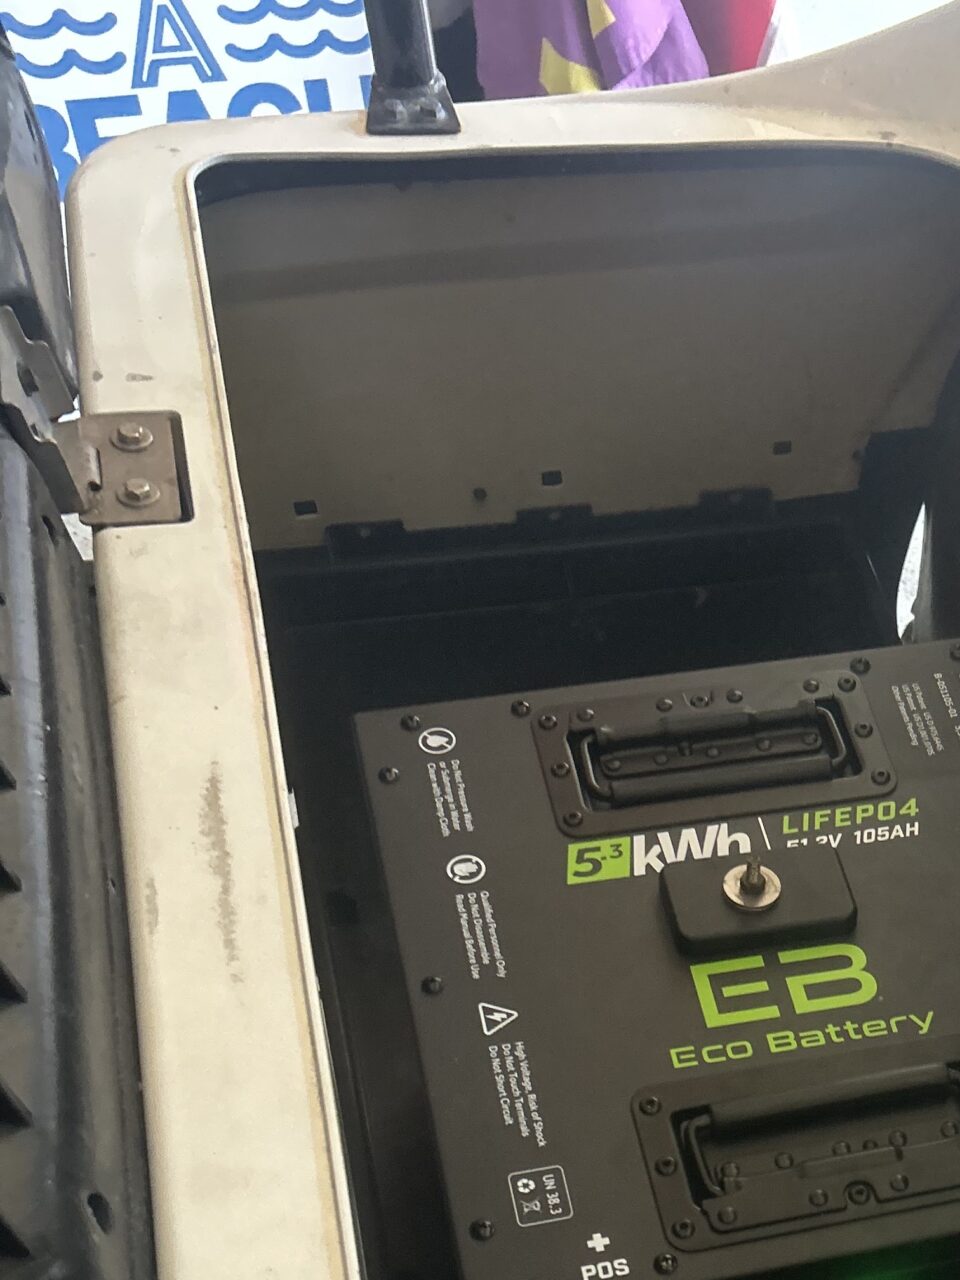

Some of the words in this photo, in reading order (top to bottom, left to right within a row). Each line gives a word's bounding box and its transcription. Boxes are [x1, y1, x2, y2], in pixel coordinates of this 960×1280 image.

[131, 0, 227, 89] A
[451, 759, 460, 770] Do
[454, 770, 462, 783] Not
[854, 822, 919, 845] 105AH
[633, 823, 751, 876] kWh
[456, 894, 466, 912] Read
[467, 892, 476, 904] Do
[471, 904, 480, 918] Not
[460, 913, 472, 938] Manual
[480, 891, 495, 923] Qualified
[488, 922, 503, 959] Personnel
[496, 959, 507, 978] Only
[465, 939, 476, 964] Before
[470, 964, 480, 979] Use
[670, 1038, 754, 1069] Eco
[766, 1010, 934, 1053] Battery
[489, 1045, 498, 1057] Do
[502, 1043, 511, 1056] Do
[514, 1041, 526, 1060] High
[492, 1058, 502, 1074] Not
[505, 1056, 515, 1071] Not
[495, 1074, 507, 1097] Short
[509, 1072, 521, 1097] Touch
[500, 1098, 513, 1125] Circuit
[528, 1094, 538, 1111] Risk
[514, 1097, 530, 1137] Terminals
[531, 1112, 542, 1120] of
[533, 1121, 547, 1147] Shock
[542, 1174, 556, 1190] UN
[546, 1192, 562, 1215] 38.3
